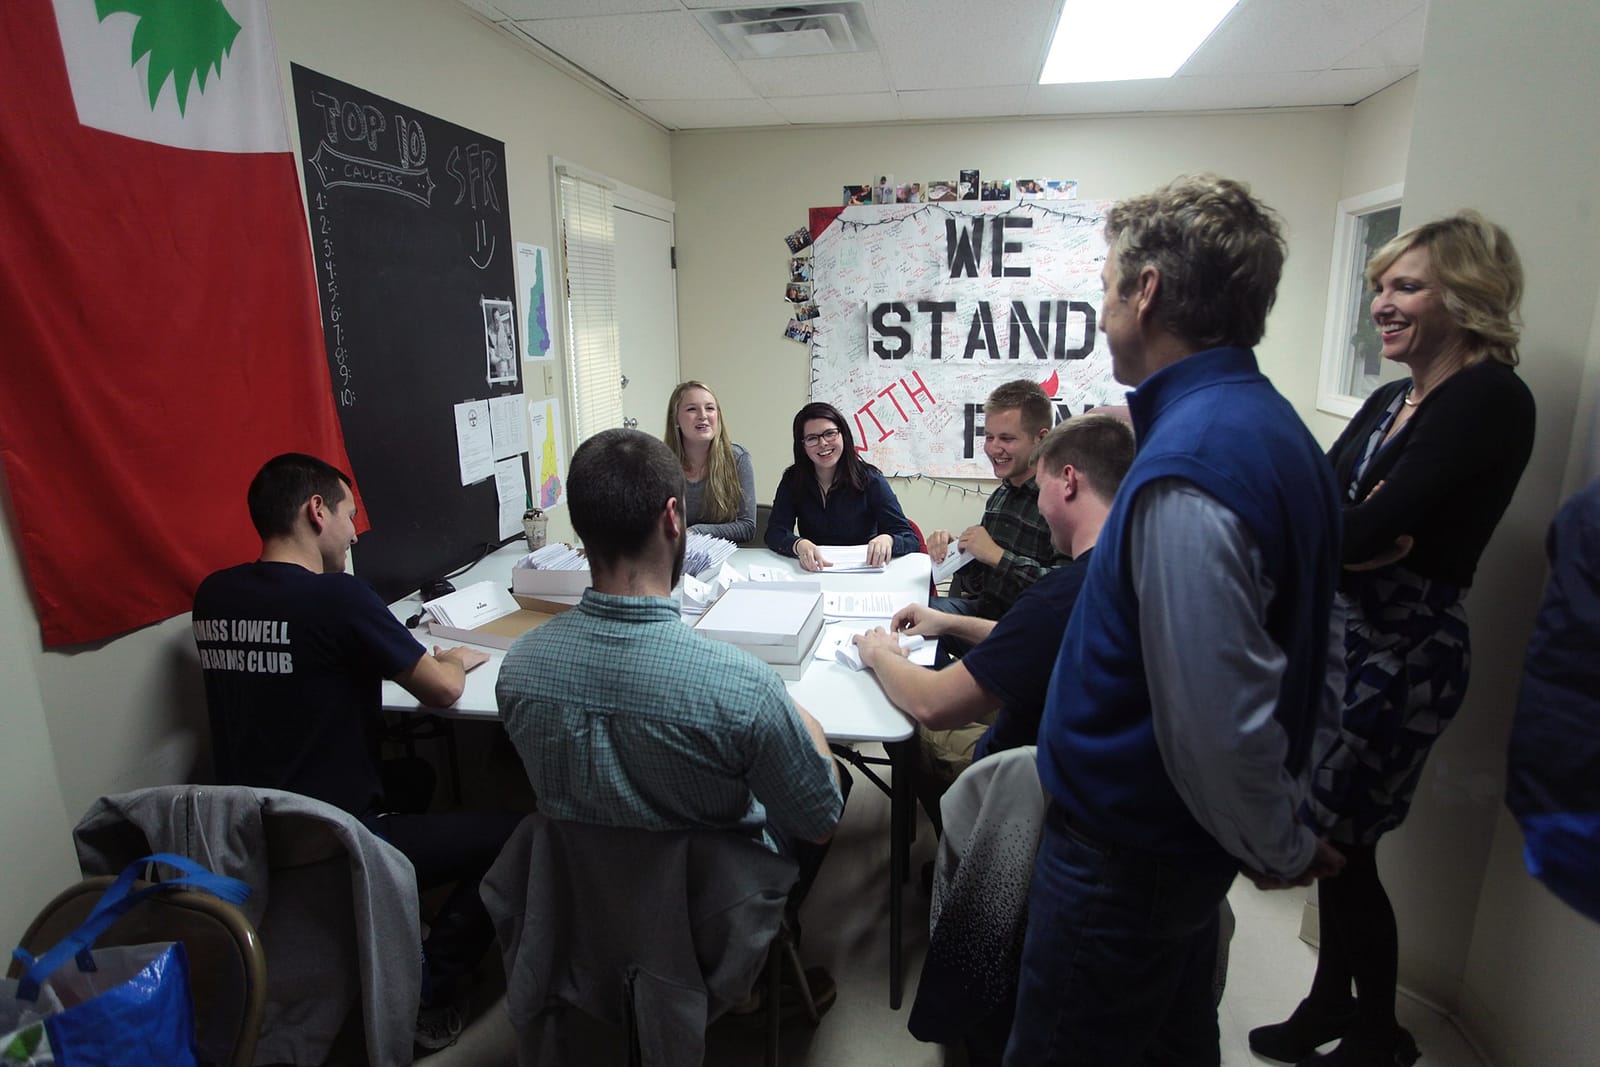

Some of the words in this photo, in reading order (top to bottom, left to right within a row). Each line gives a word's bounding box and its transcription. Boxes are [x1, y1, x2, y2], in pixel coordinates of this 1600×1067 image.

[311, 90, 386, 152] TOP
[395, 115, 427, 168] 10
[344, 164, 403, 186] CALLERS
[445, 143, 500, 213] SFR
[945, 216, 1033, 278] WE
[870, 300, 1097, 360] STAND
[340, 388, 356, 407] 10:
[231, 619, 291, 645] LOWELL
[246, 650, 294, 674] CLUB
